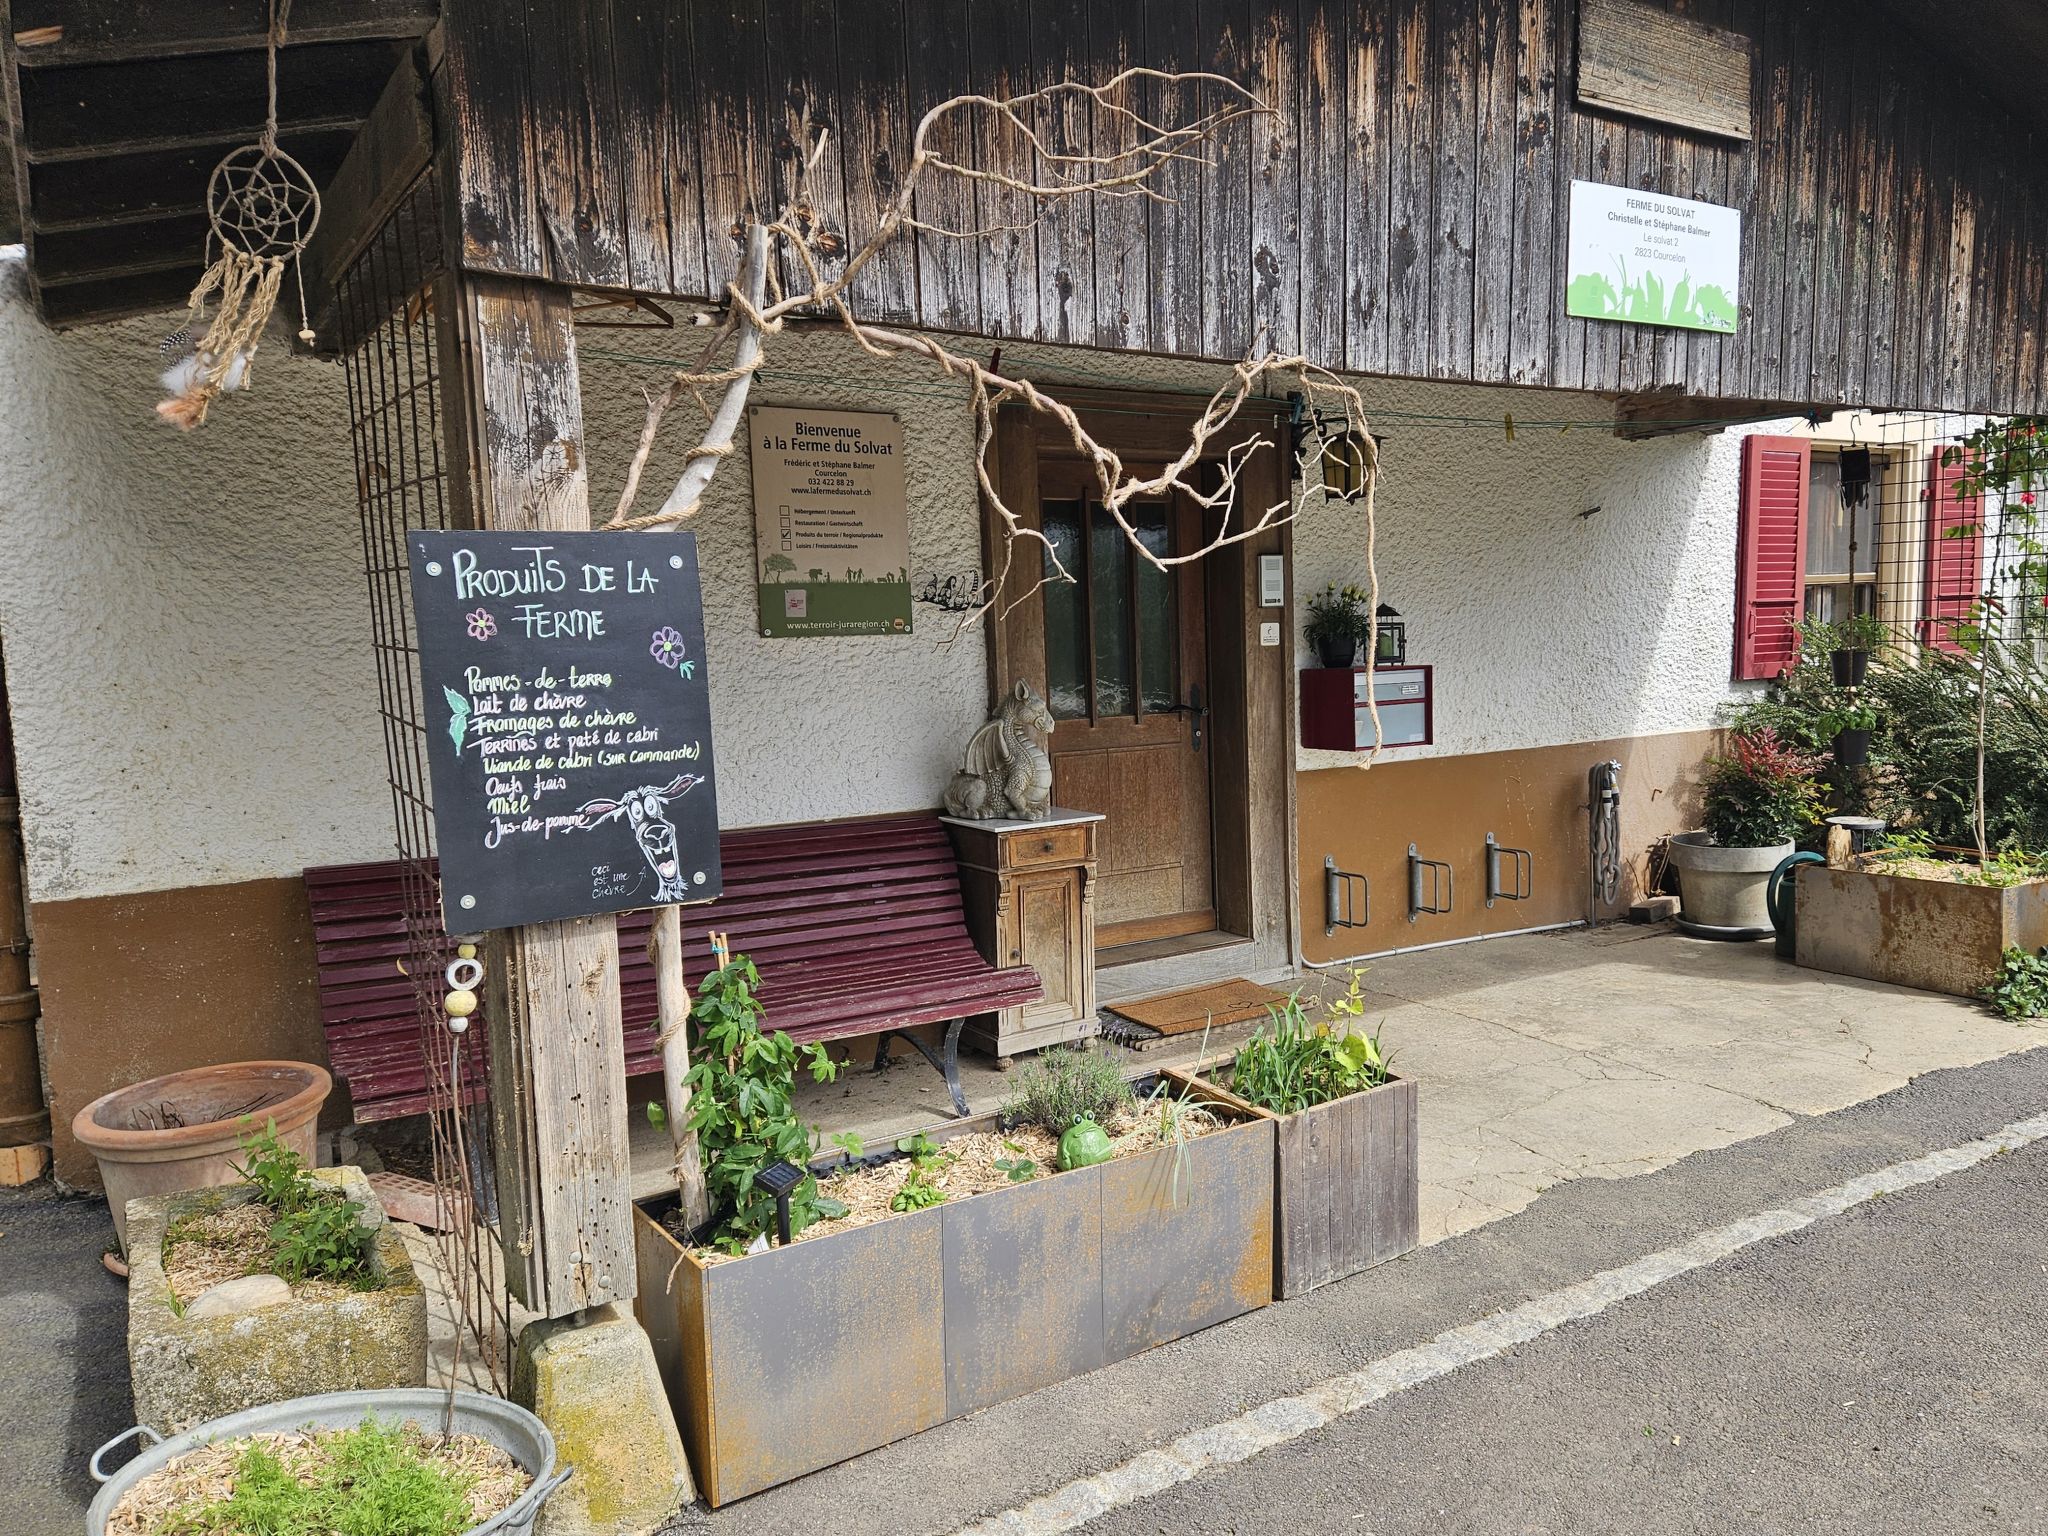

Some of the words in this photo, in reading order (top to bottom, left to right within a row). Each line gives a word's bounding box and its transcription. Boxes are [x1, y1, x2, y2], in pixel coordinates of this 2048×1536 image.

[1626, 198, 1652, 211] FERME
[1654, 203, 1665, 214] DU
[1667, 206, 1695, 219] SOLVAT
[1607, 211, 1643, 226] Christelle
[1644, 219, 1652, 227] et
[1653, 218, 1686, 233] Stéphane
[1687, 224, 1711, 237] Balmer
[1643, 232, 1652, 242] Le
[1653, 235, 1674, 246] solvat
[1674, 238, 1679, 247] 2
[1634, 247, 1652, 258] 2823
[1653, 249, 1686, 263] Courcelon
[795, 422, 861, 438] Bienvenue
[763, 436, 771, 449] à
[775, 436, 787, 450] la
[791, 438, 831, 452] Ferme
[834, 439, 850, 453] du
[854, 441, 893, 455] Solvat
[784, 458, 811, 467] Frédéric
[821, 460, 851, 470] Stéphane
[814, 469, 848, 477] Courcelon
[808, 478, 820, 486] 032
[846, 479, 854, 487] 29
[790, 486, 872, 496] www.lafermedusolvat.ch
[578, 563, 616, 593] DE
[626, 560, 660, 594] LA
[786, 620, 890, 631] www.terroir-juraregion.ch
[472, 693, 503, 716] Lait
[509, 693, 527, 711] de
[558, 713, 581, 729] de
[545, 732, 561, 750] et
[604, 729, 622, 746] de
[626, 726, 659, 744] cabri
[535, 755, 554, 770] de
[557, 752, 592, 770] cabri
[533, 773, 567, 800] frais
[486, 795, 531, 815] Miel
[593, 874, 609, 886] est
[613, 871, 631, 883] une
